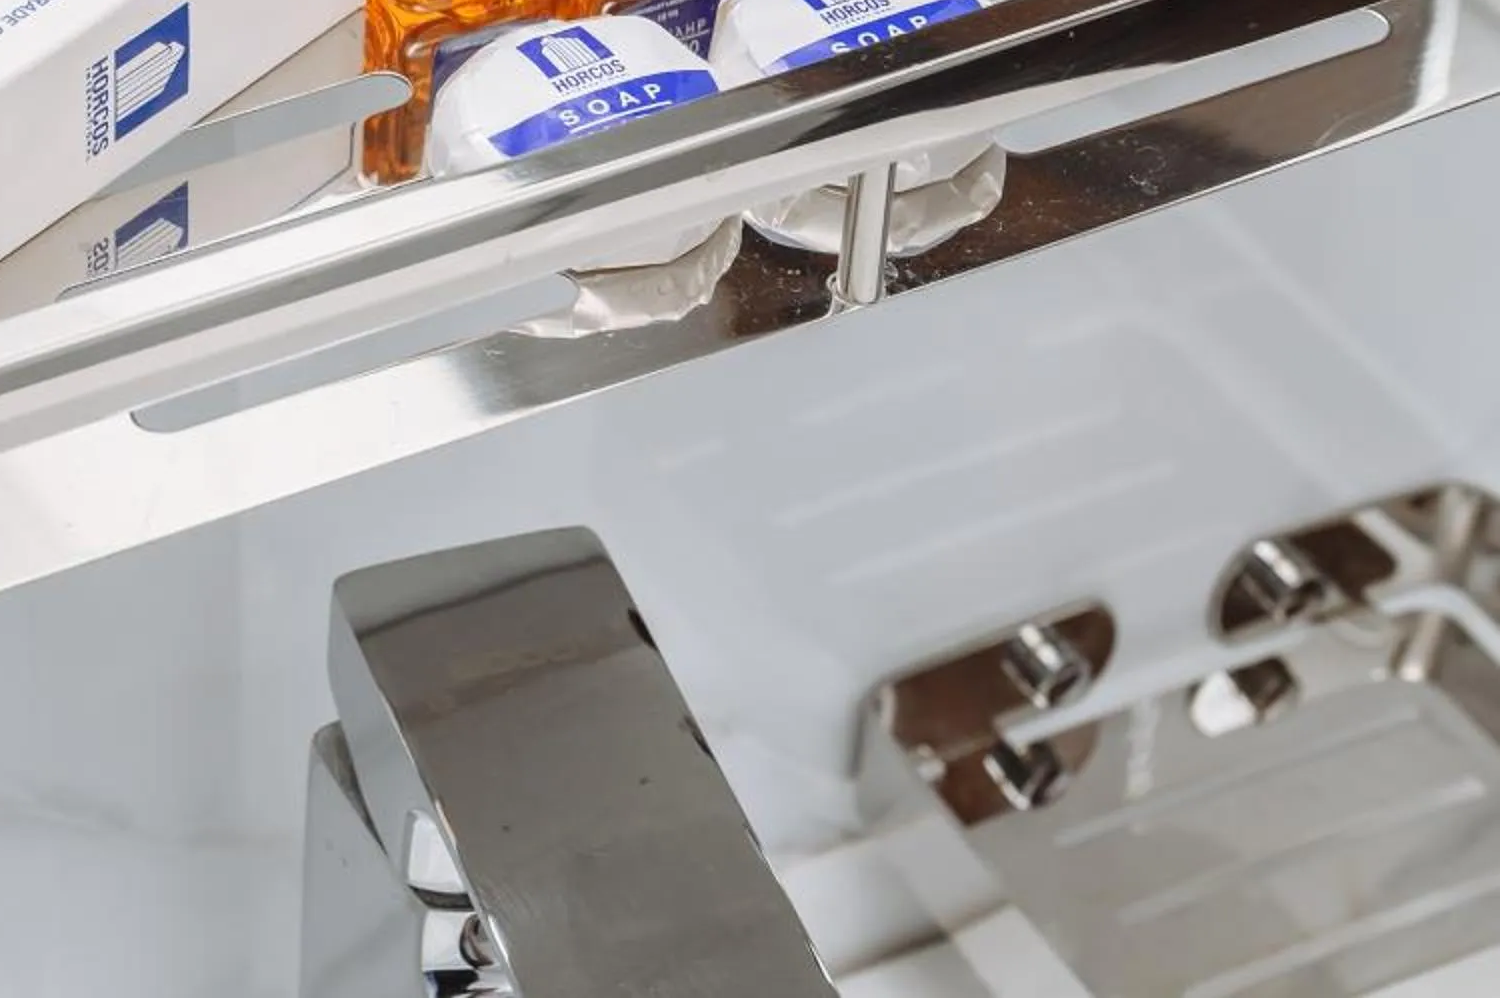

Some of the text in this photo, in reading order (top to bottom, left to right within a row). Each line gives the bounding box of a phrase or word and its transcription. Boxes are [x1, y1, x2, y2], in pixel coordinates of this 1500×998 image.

[830, 15, 928, 54] SOAP
[552, 58, 626, 93] HORCOS
[91, 54, 109, 156] HORCOS
[559, 83, 661, 126] SOAP
